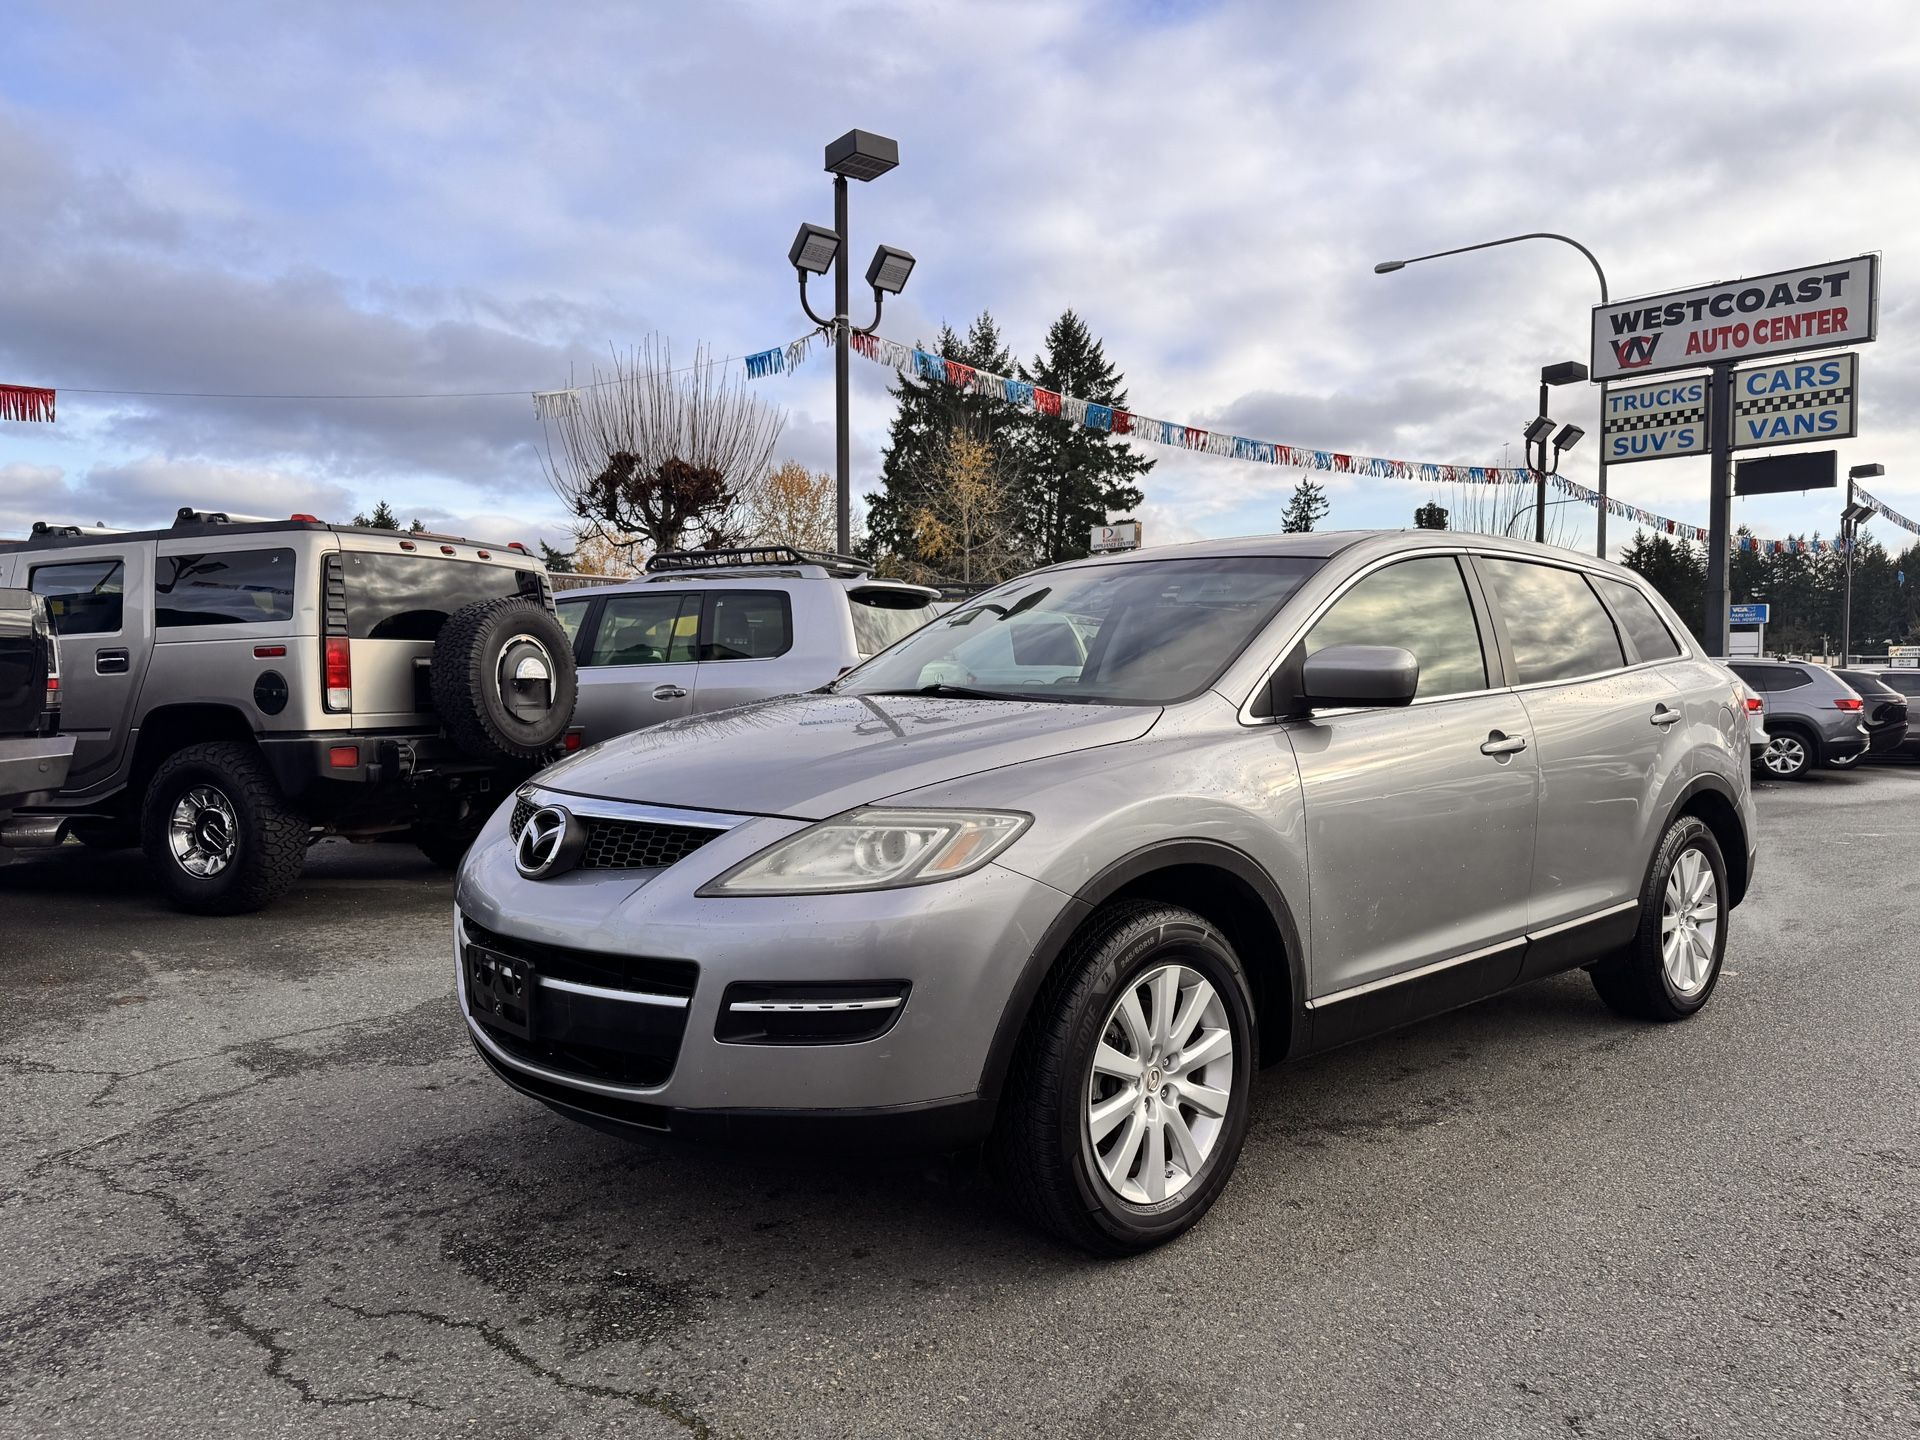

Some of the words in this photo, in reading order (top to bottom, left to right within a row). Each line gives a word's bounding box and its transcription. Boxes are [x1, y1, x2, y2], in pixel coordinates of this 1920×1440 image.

[1609, 270, 1850, 336] WESTCOAST
[1685, 323, 1749, 356] AUTO
[1753, 307, 1849, 345] CENTER
[1746, 362, 1841, 395] CARS
[1609, 385, 1702, 413] TRUCKS
[1748, 410, 1838, 440] VANS
[1613, 428, 1695, 456] SUV'S
